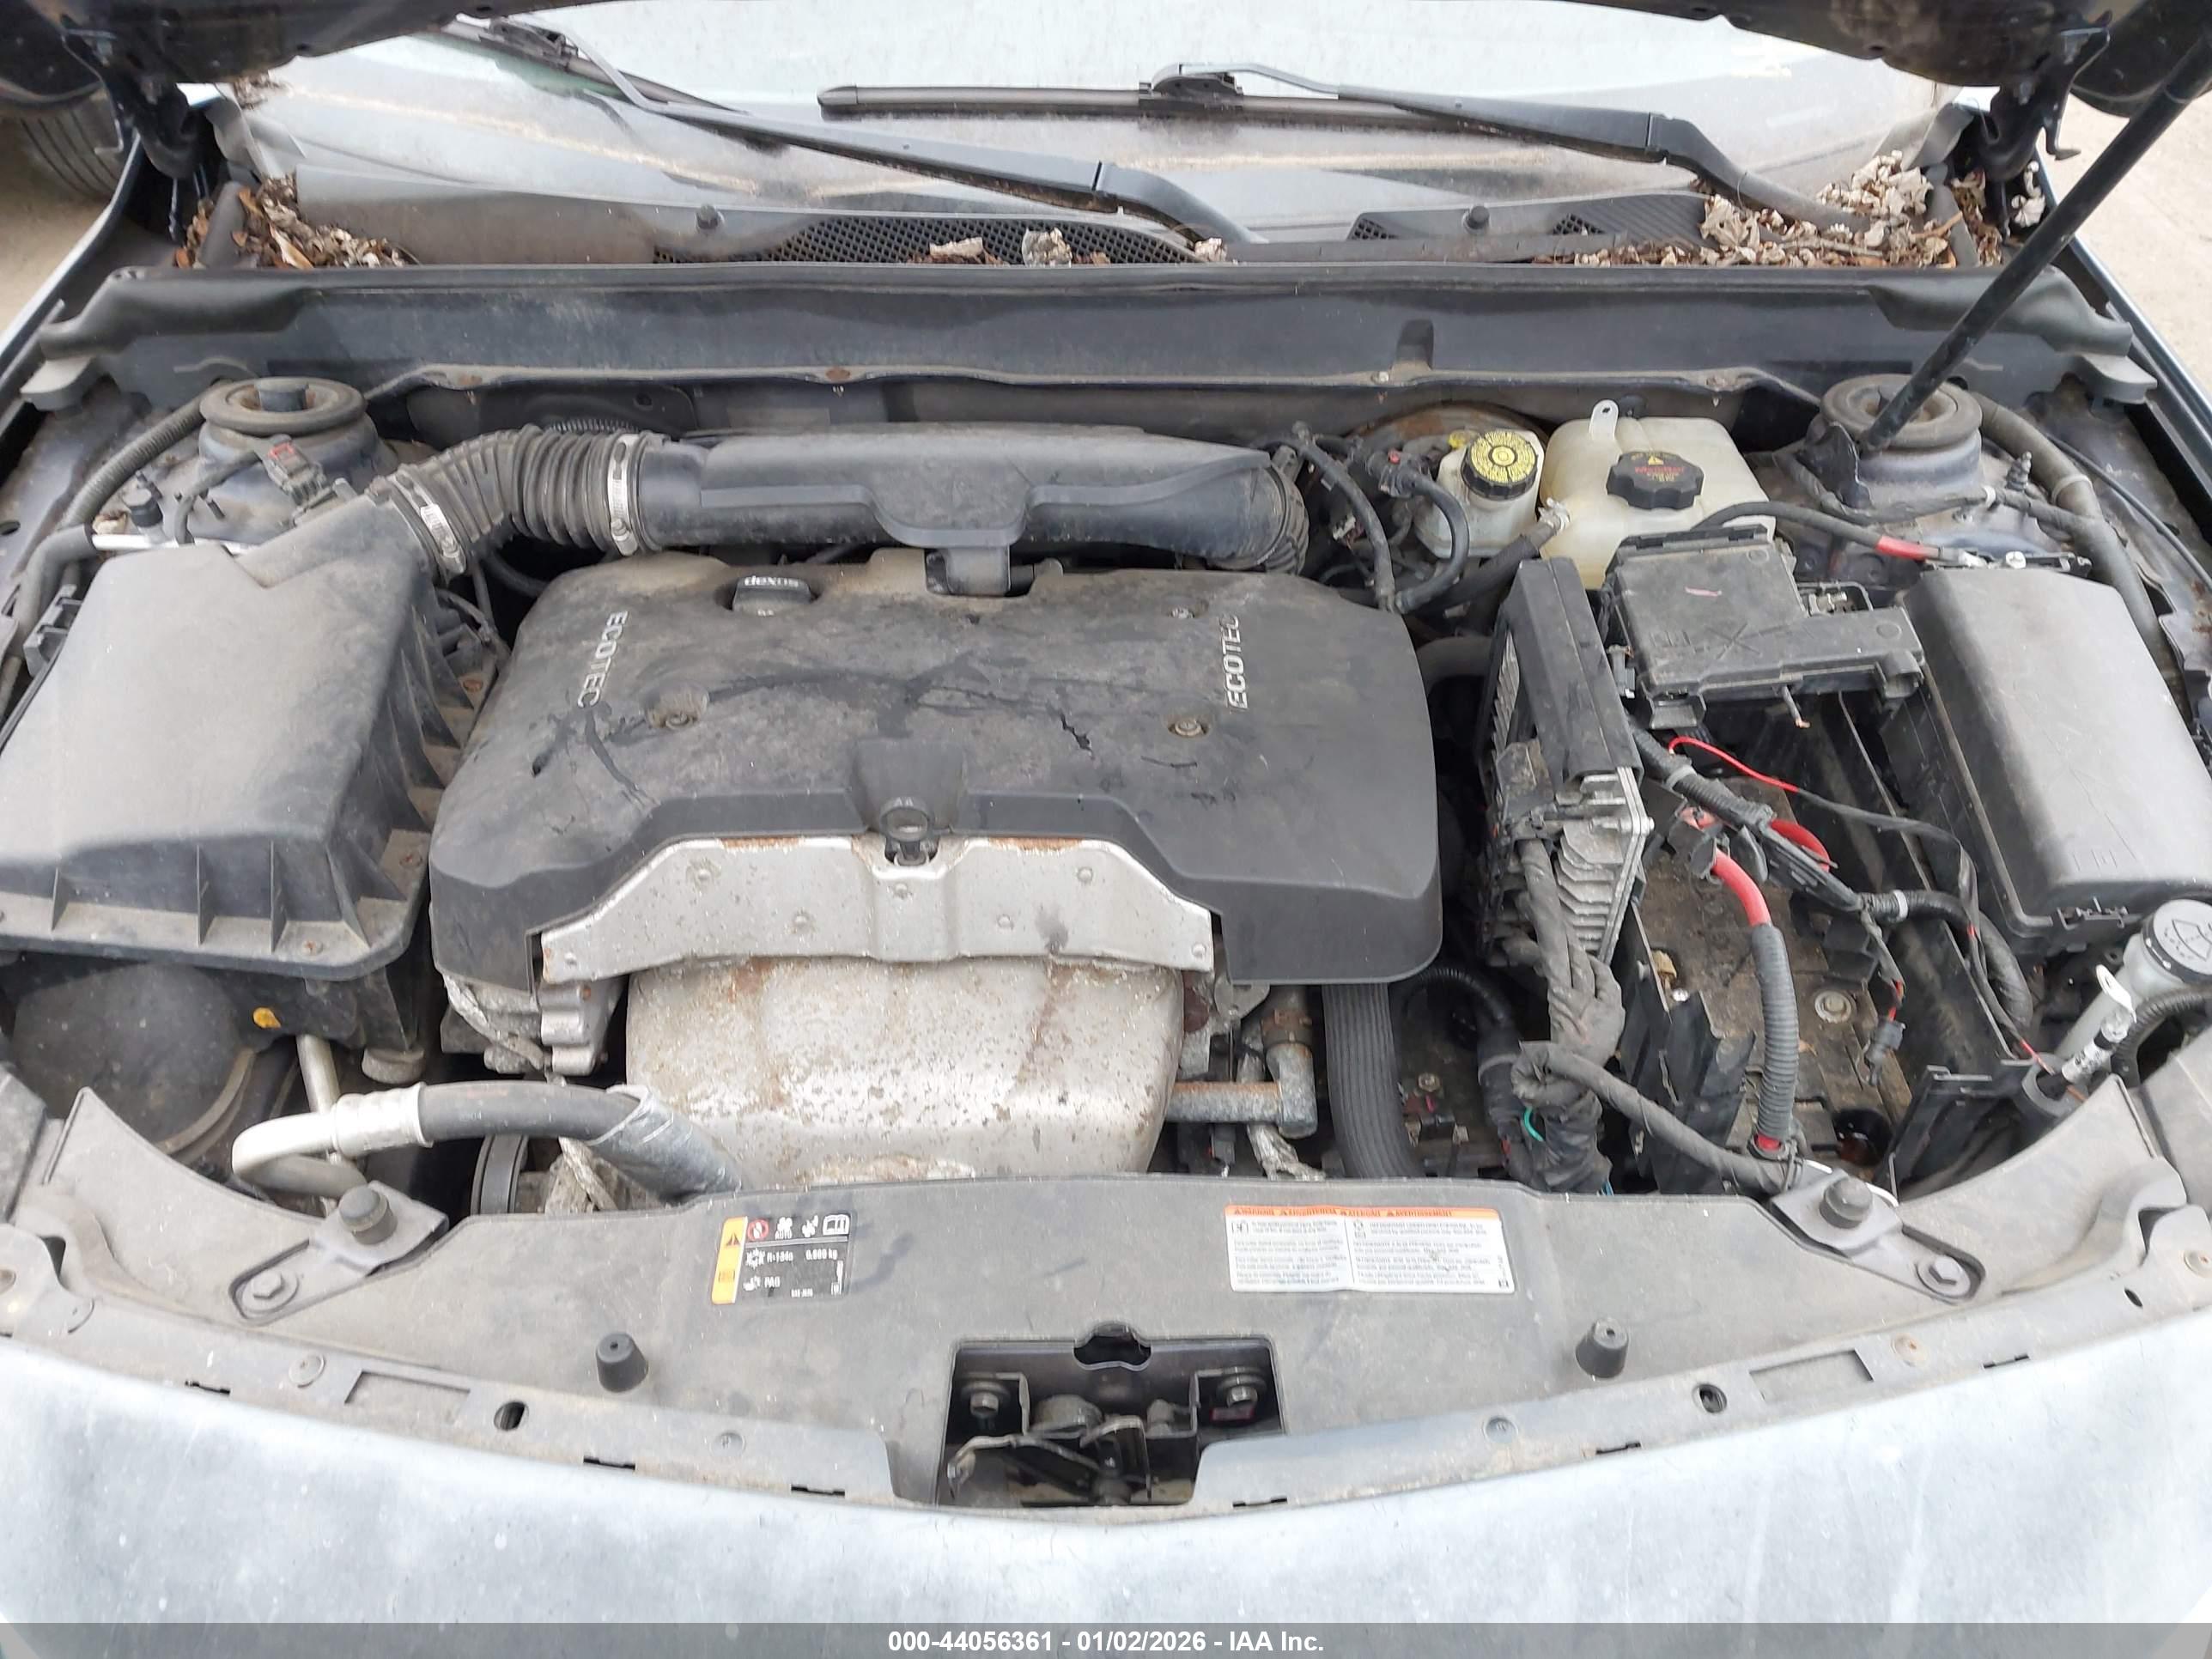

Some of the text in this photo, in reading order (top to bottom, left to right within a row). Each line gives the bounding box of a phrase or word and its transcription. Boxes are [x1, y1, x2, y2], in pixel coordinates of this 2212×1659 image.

[744, 575, 799, 587] dexos
[577, 611, 629, 708] ECOTEC
[1218, 615, 1248, 708] ECOTEC
